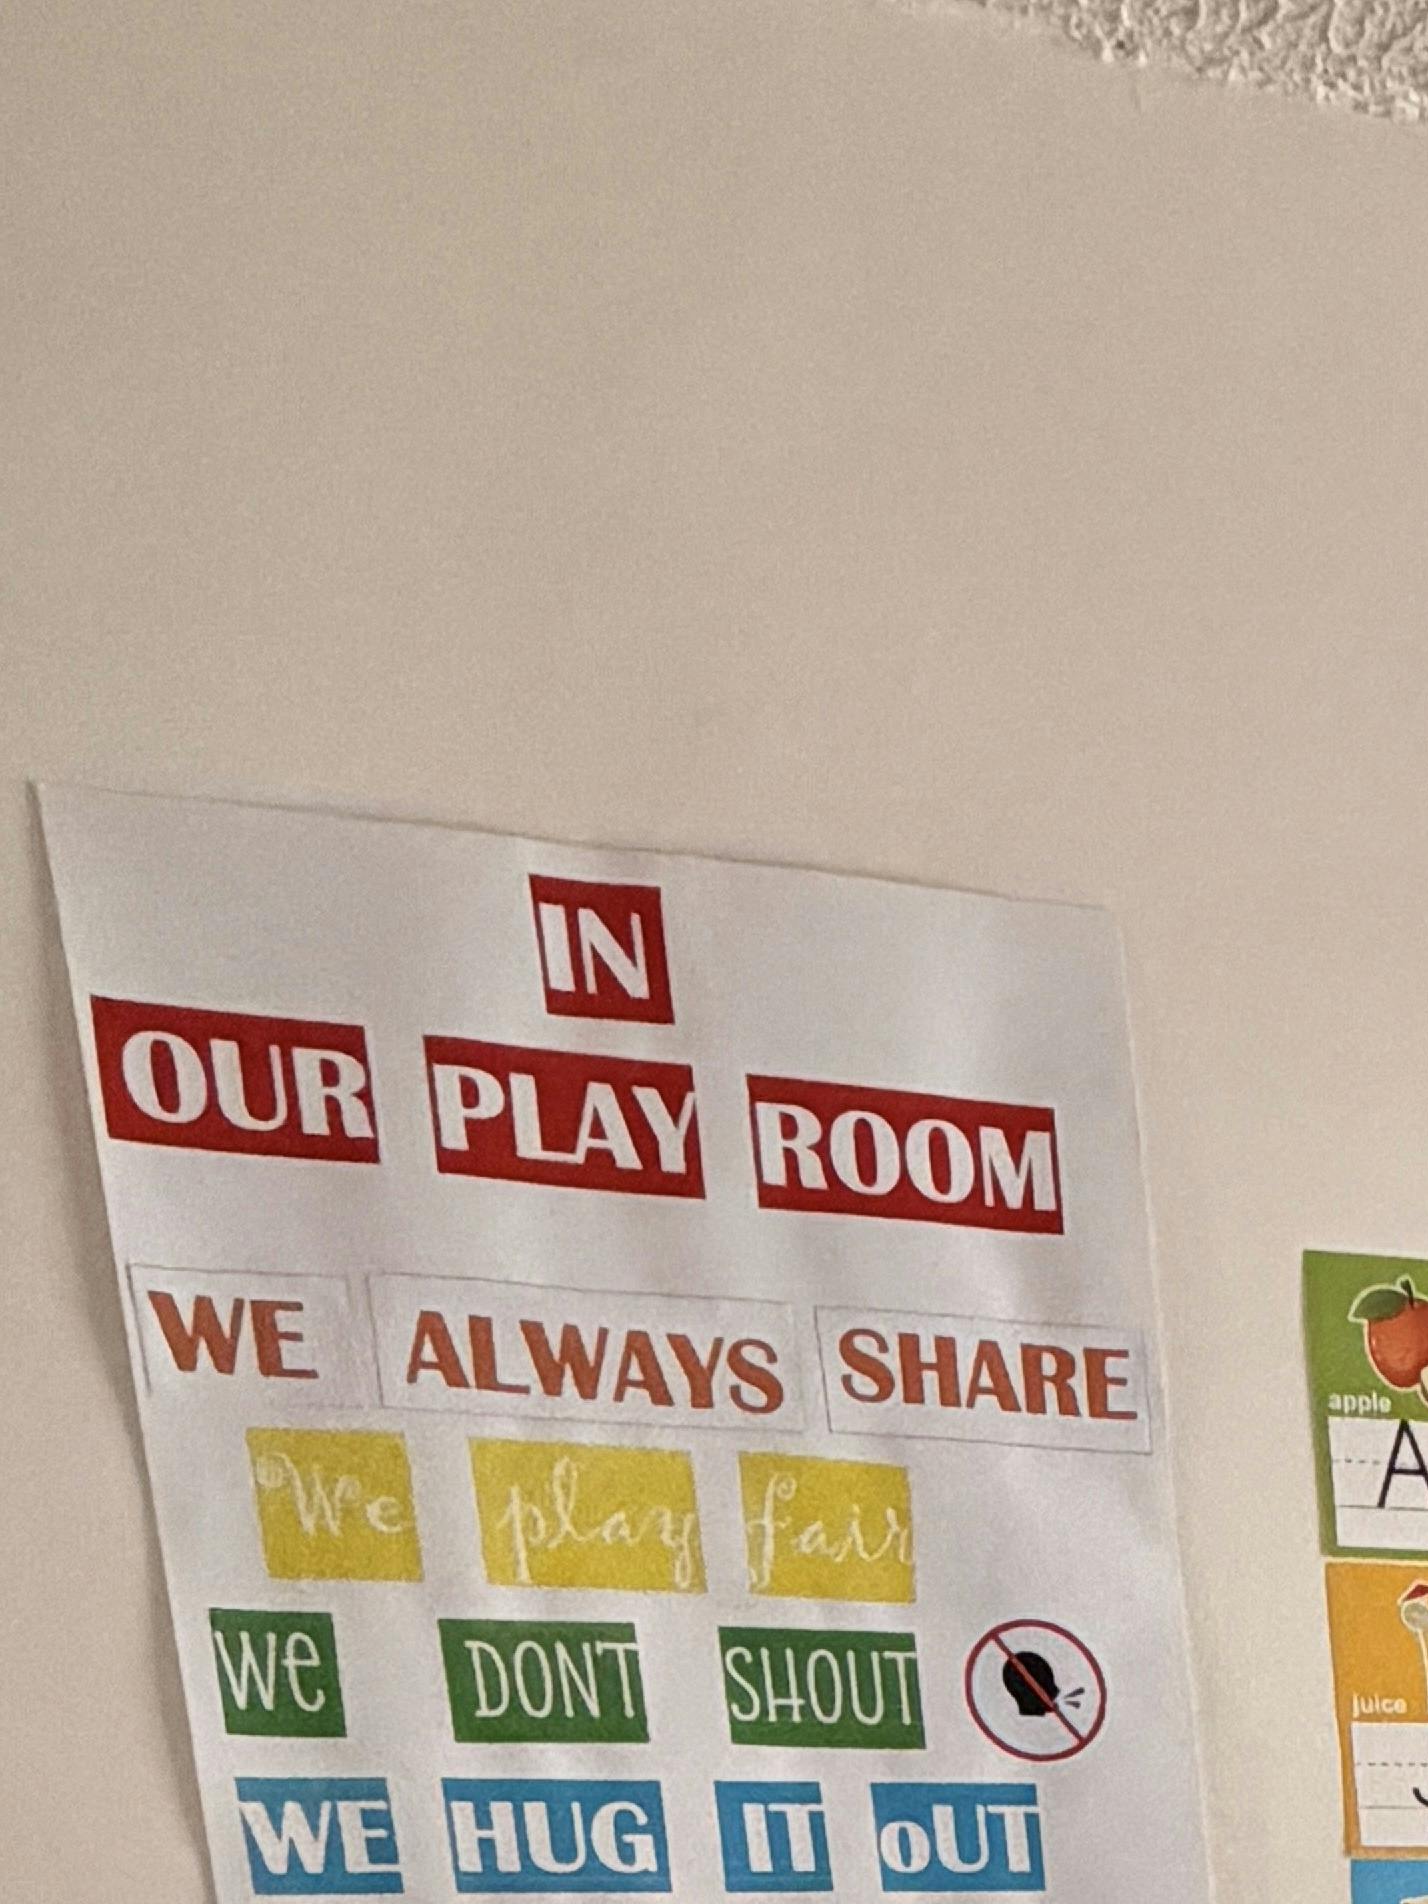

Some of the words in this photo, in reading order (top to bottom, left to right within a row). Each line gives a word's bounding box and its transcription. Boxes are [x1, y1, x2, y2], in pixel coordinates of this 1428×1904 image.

[541, 900, 648, 998] IN
[122, 1029, 375, 1140] OUR
[431, 1069, 697, 1177] PLAY
[759, 1107, 1057, 1213] ROOM
[149, 1291, 319, 1379] WE
[405, 1310, 784, 1413] ALWAYS
[839, 1328, 1139, 1420] SHARE
[1328, 1393, 1392, 1417] apple
[255, 1452, 411, 1536] We
[499, 1456, 698, 1587] play
[748, 1471, 913, 1588] fair
[214, 1631, 323, 1712] We
[725, 1647, 916, 1725] SHOUT
[1351, 1694, 1406, 1718] juice
[243, 1799, 398, 1879] WE
[454, 1799, 659, 1875] HUG
[745, 1801, 827, 1875] IT
